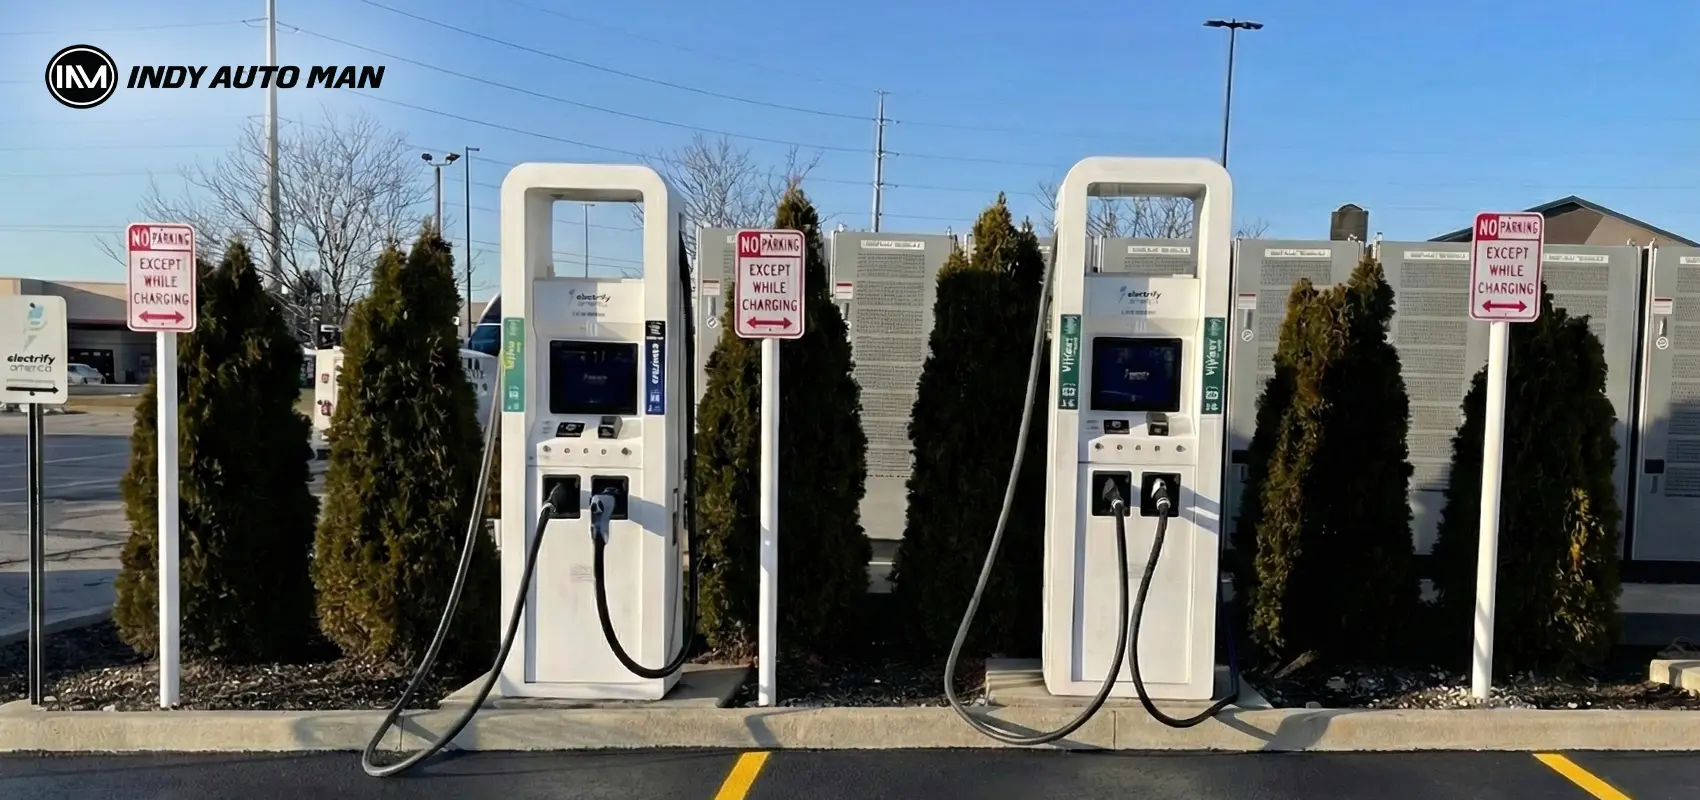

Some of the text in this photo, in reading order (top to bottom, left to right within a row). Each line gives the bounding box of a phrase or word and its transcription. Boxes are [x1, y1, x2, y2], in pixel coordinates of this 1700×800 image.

[1480, 219, 1539, 236] NO PARKING
[131, 228, 190, 247] NO PARKING
[741, 236, 800, 253] NO PARKING
[1486, 246, 1529, 260] EXCEPT
[139, 257, 181, 270] EXCEPT
[749, 263, 791, 277] EXCEPT
[1489, 264, 1524, 277] WHILE
[144, 275, 178, 288] WHILE
[752, 281, 787, 294] WHILE
[1478, 282, 1534, 295] CHARGING
[133, 292, 189, 306] CHARGING
[742, 299, 798, 312] CHARGING
[7, 353, 56, 365] electrify
[9, 364, 52, 373] amerca
